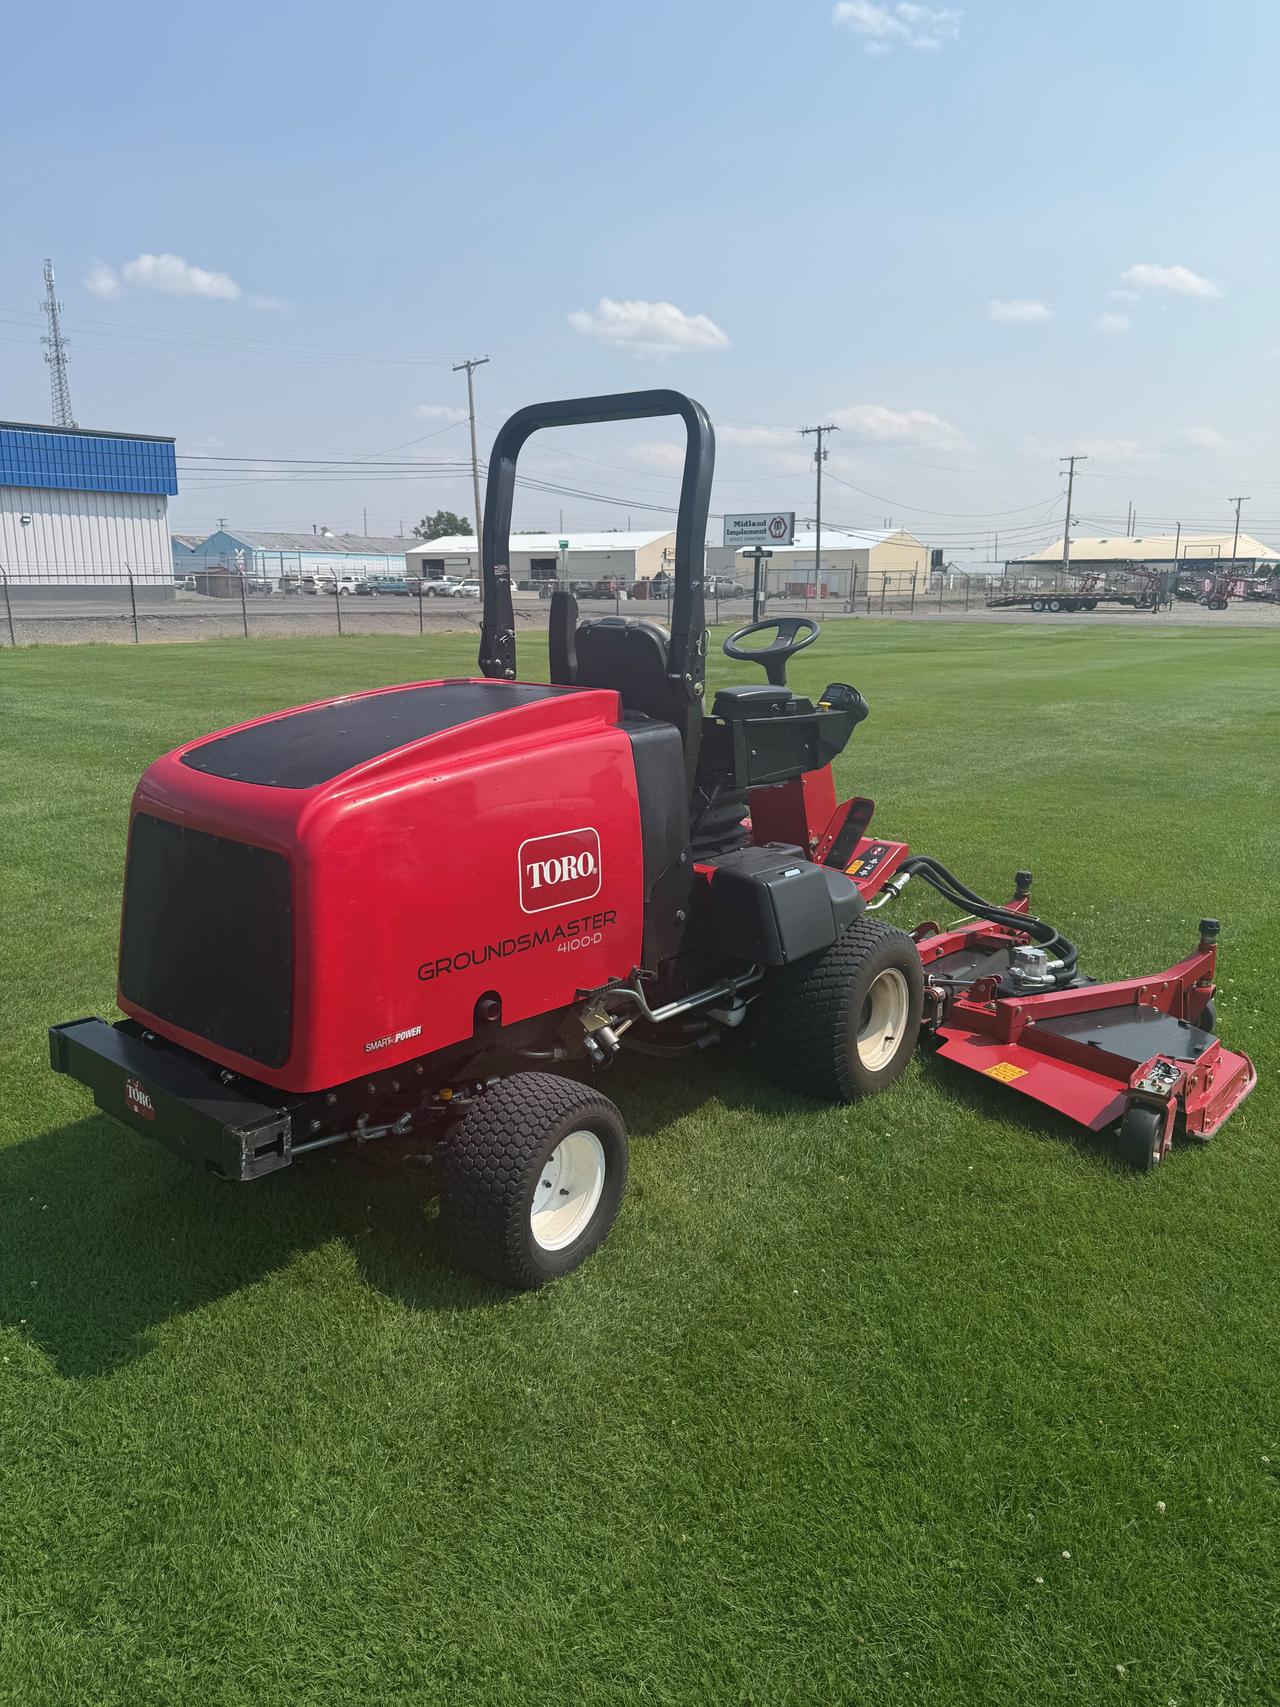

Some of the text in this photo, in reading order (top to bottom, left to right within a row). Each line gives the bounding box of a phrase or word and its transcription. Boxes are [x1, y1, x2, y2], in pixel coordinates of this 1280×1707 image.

[726, 528, 767, 536] Implement
[526, 851, 594, 889] TORO
[417, 910, 617, 981] GROUNDSMASTER
